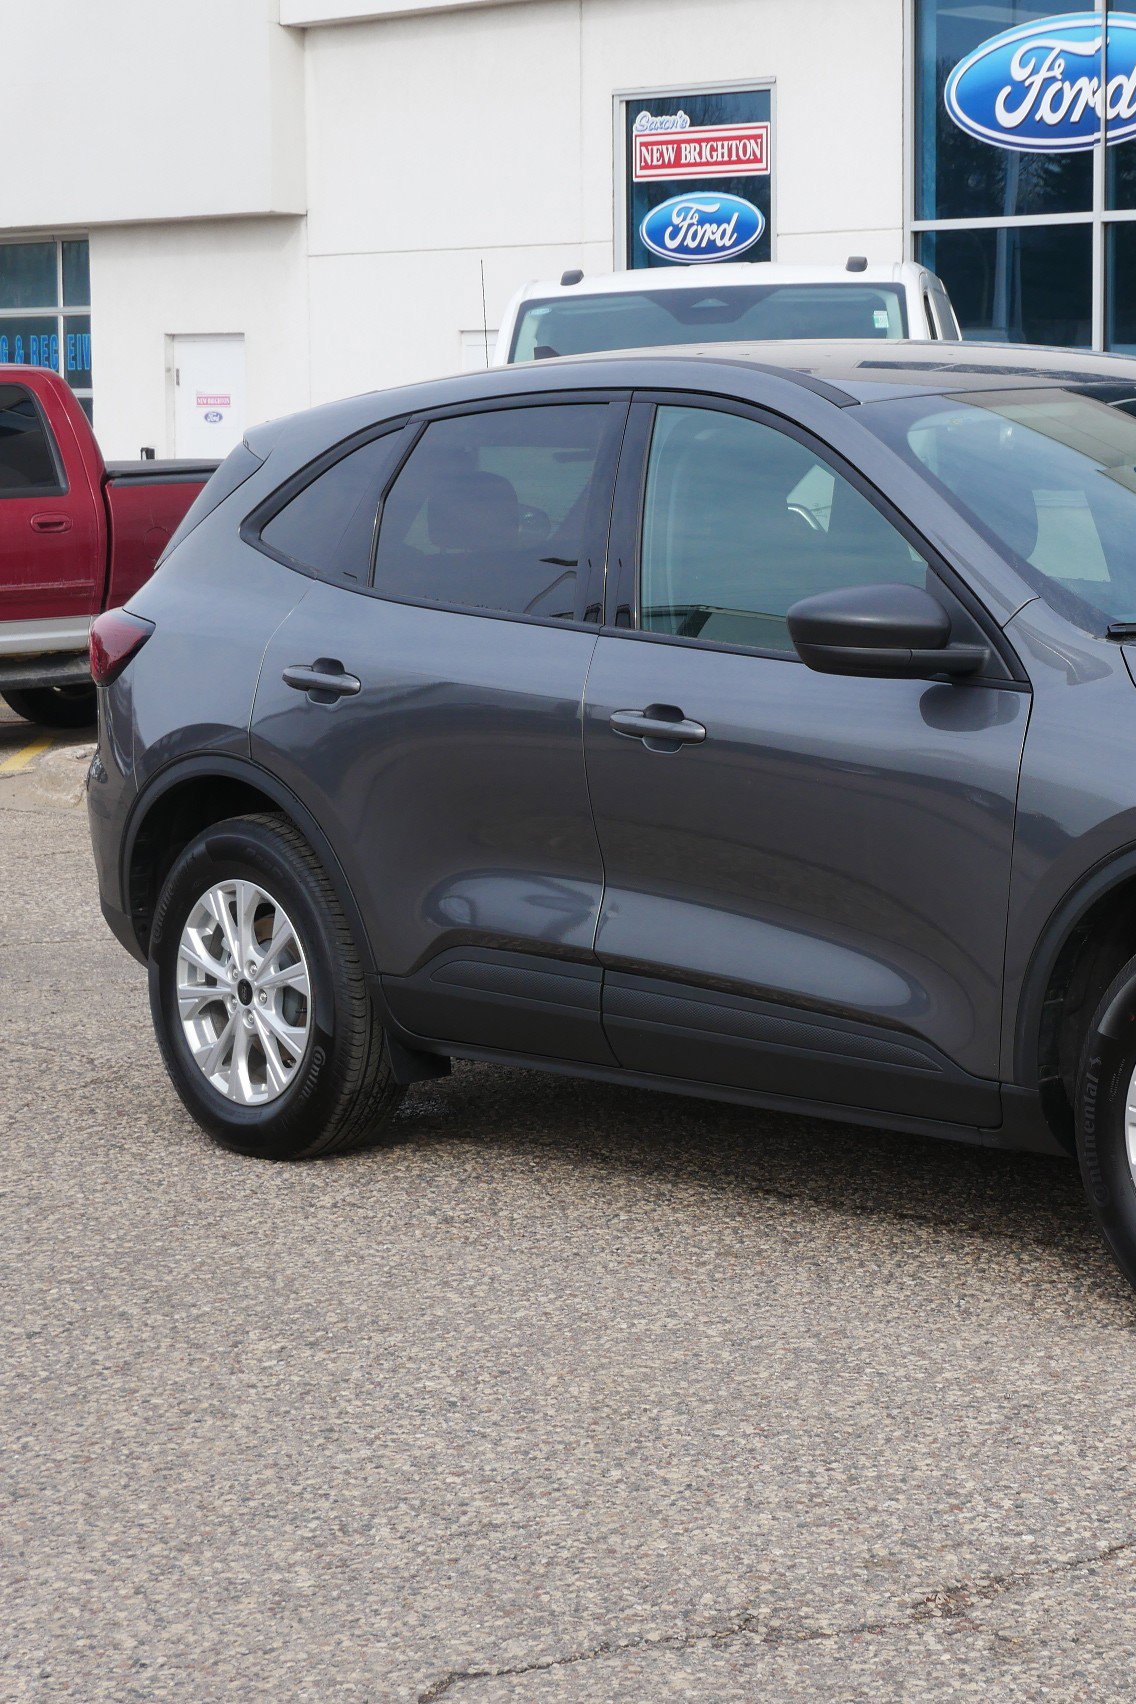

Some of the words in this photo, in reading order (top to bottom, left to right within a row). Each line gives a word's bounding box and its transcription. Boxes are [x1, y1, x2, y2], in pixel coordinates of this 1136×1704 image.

[634, 112, 689, 133] Saxon's
[640, 143, 677, 167] NEW
[680, 138, 762, 165] BRIGHTON
[664, 202, 740, 249] Ford
